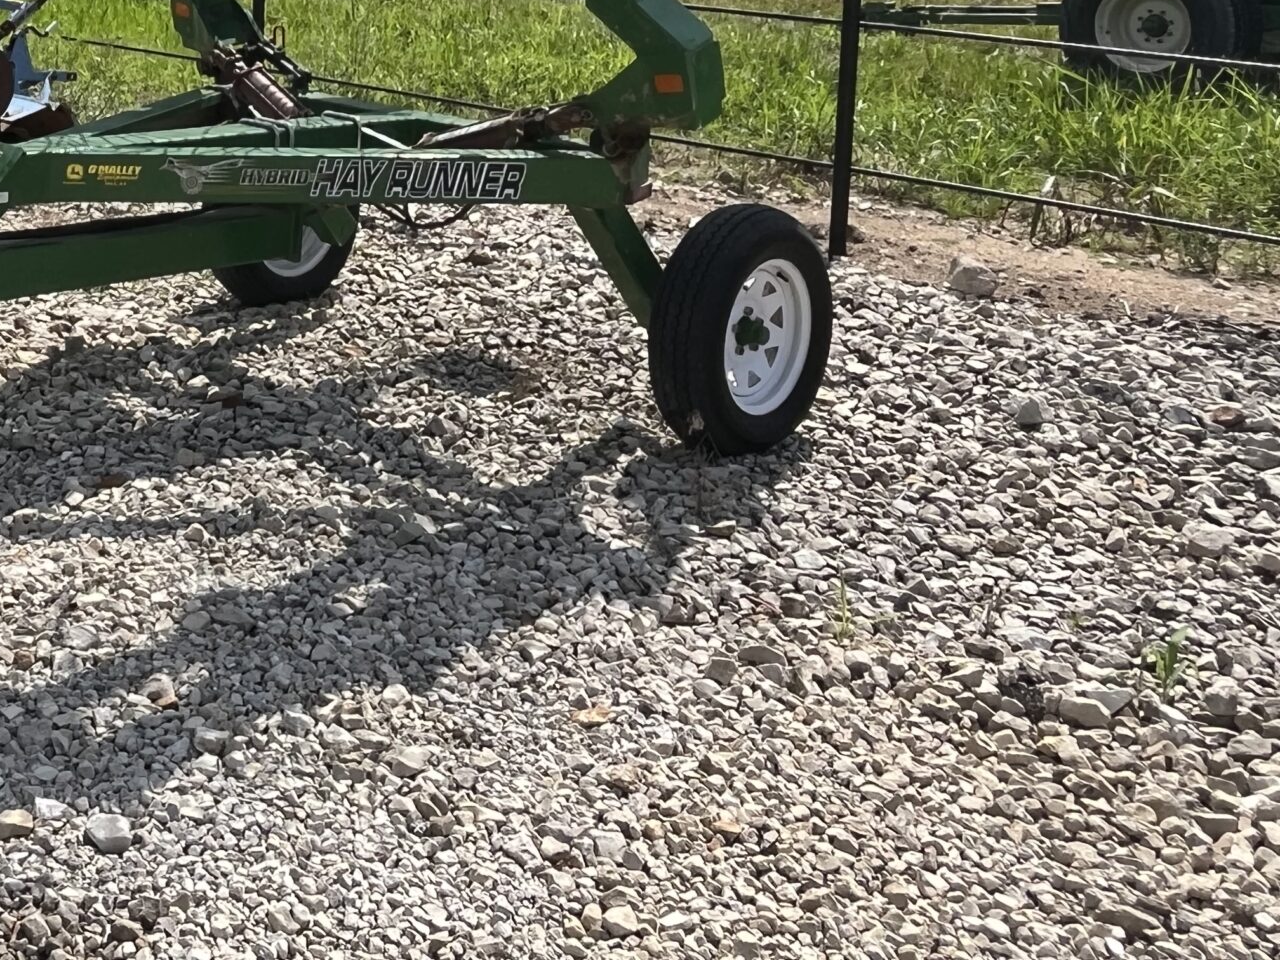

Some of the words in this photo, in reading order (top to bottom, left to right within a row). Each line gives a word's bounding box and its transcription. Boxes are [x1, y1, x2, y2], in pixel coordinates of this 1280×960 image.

[239, 168, 310, 186] HYBRID
[310, 158, 388, 198] HAY
[384, 160, 527, 200] RUNNER
